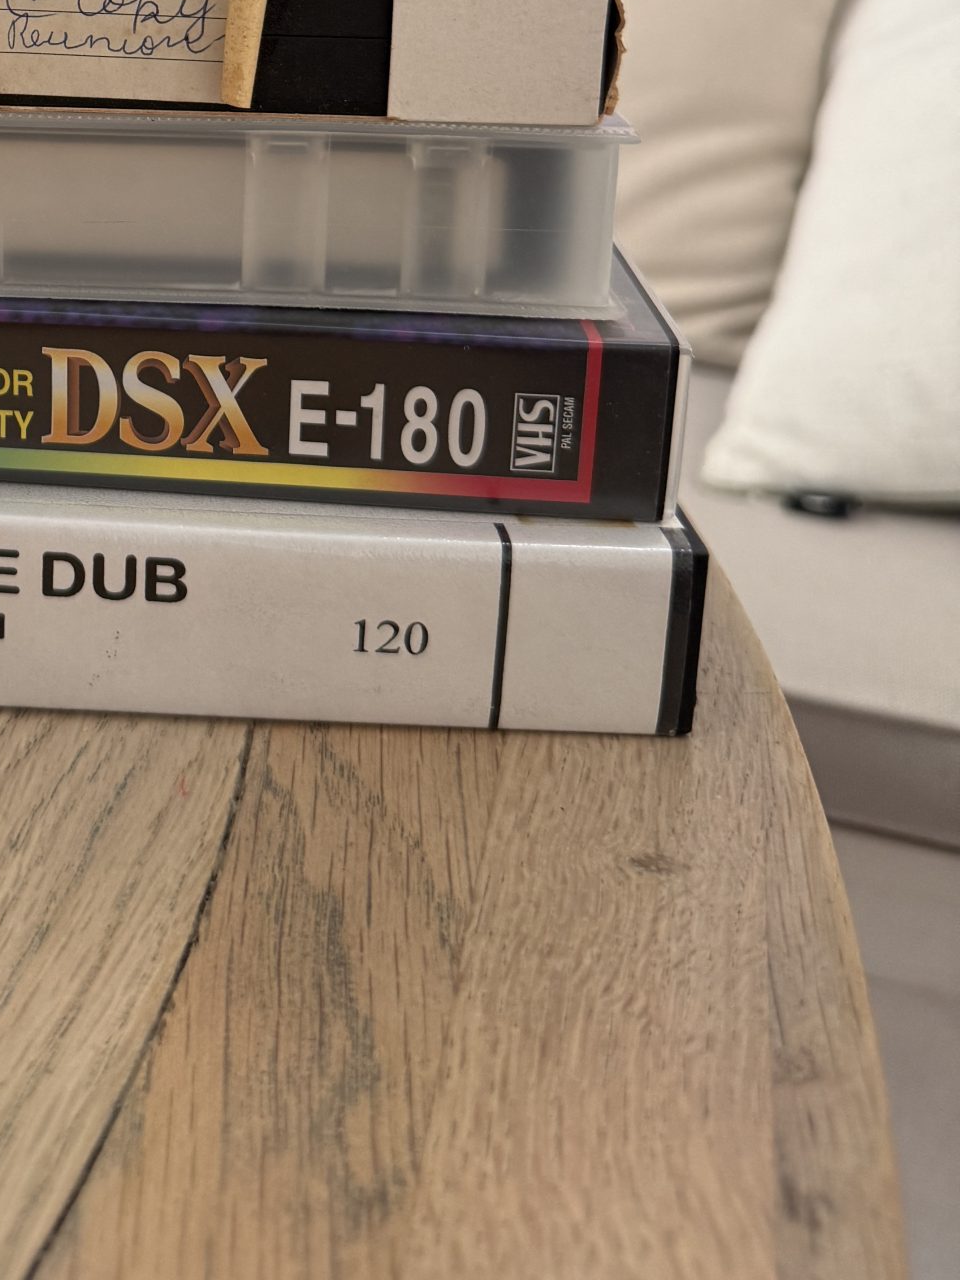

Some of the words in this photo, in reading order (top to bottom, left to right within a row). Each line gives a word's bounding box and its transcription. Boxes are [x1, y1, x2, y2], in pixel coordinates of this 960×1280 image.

[41, 346, 269, 457] DSX
[288, 379, 487, 467] E-180
[561, 397, 576, 430] SECAM
[514, 397, 556, 468] VHS
[560, 433, 572, 449] PAL
[41, 550, 189, 604] DUB
[351, 617, 431, 657] 120
